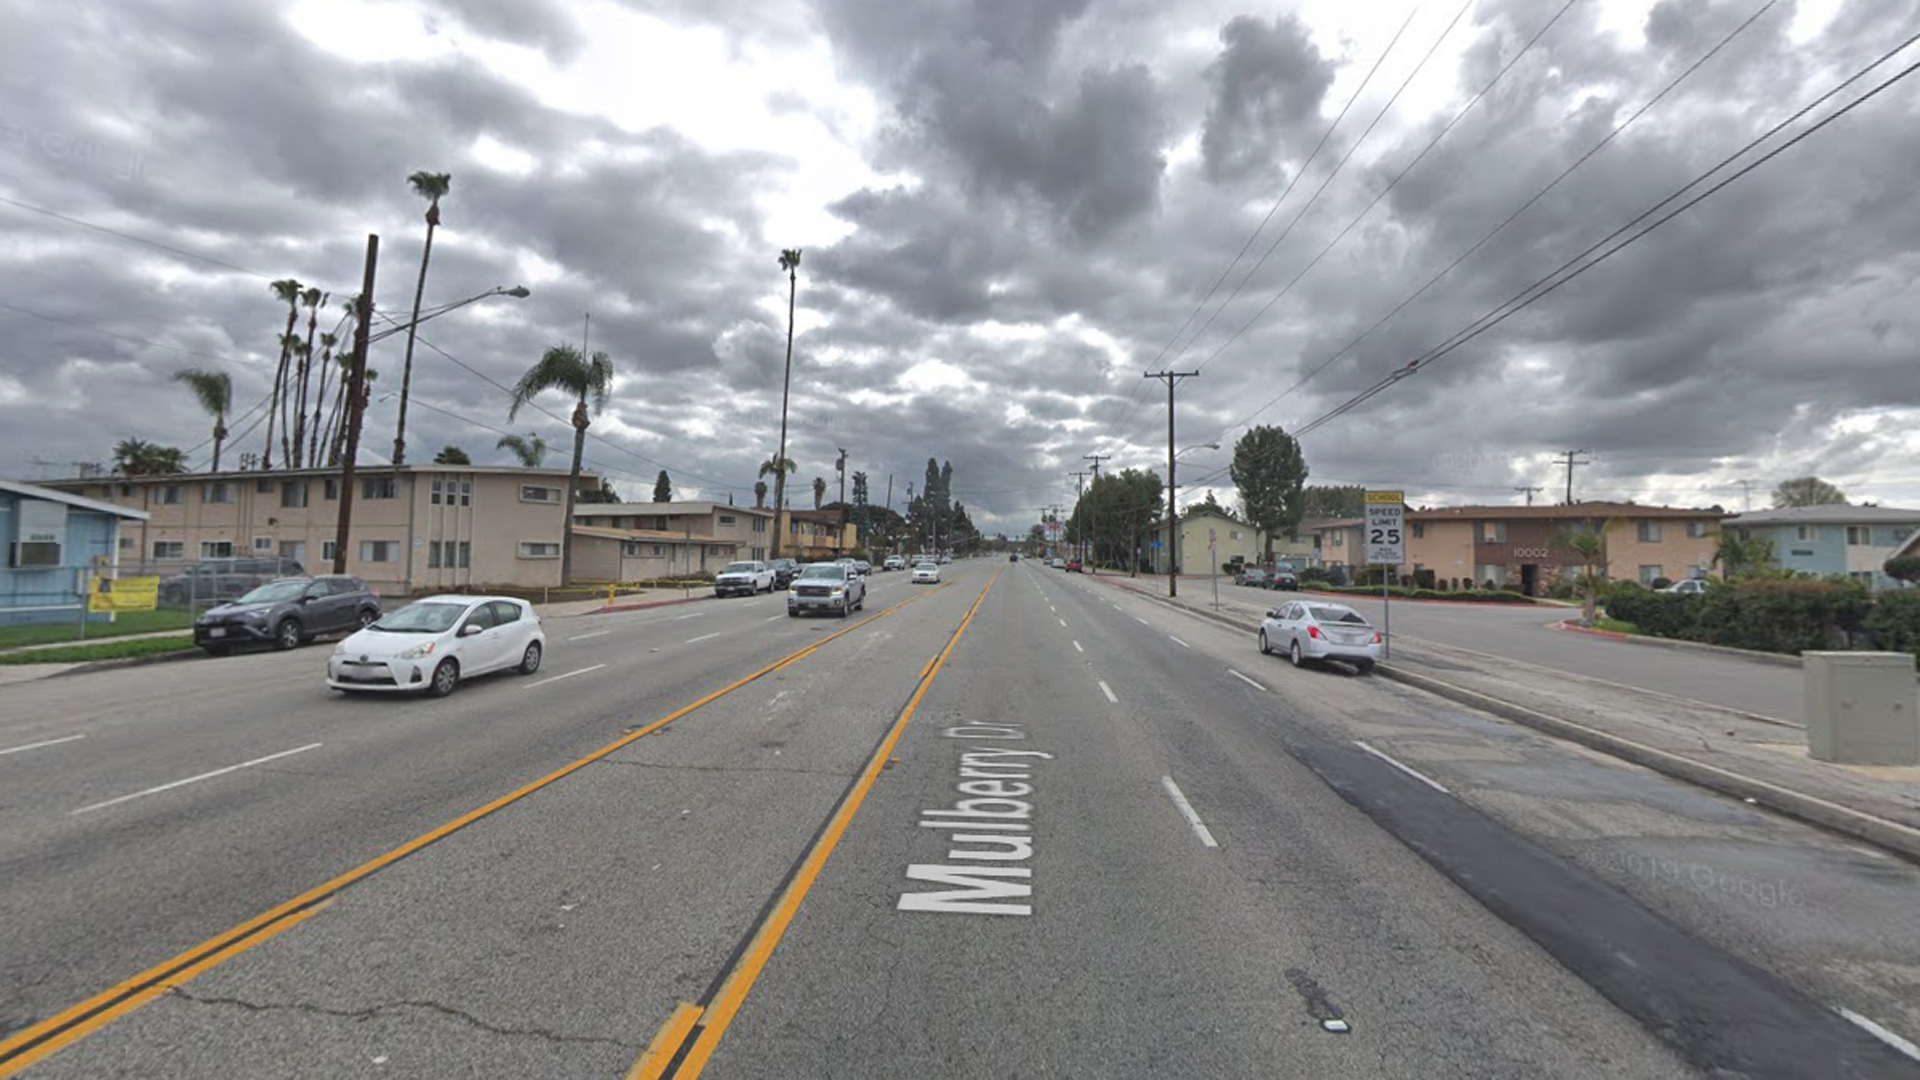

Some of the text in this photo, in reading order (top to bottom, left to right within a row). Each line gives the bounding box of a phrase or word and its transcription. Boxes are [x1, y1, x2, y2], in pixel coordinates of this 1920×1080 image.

[1368, 494, 1401, 502] SCHOOL
[1368, 508, 1401, 516] SPEED
[1371, 518, 1398, 526] LIMIT
[1370, 529, 1401, 545] 25
[1513, 547, 1550, 558] 10002
